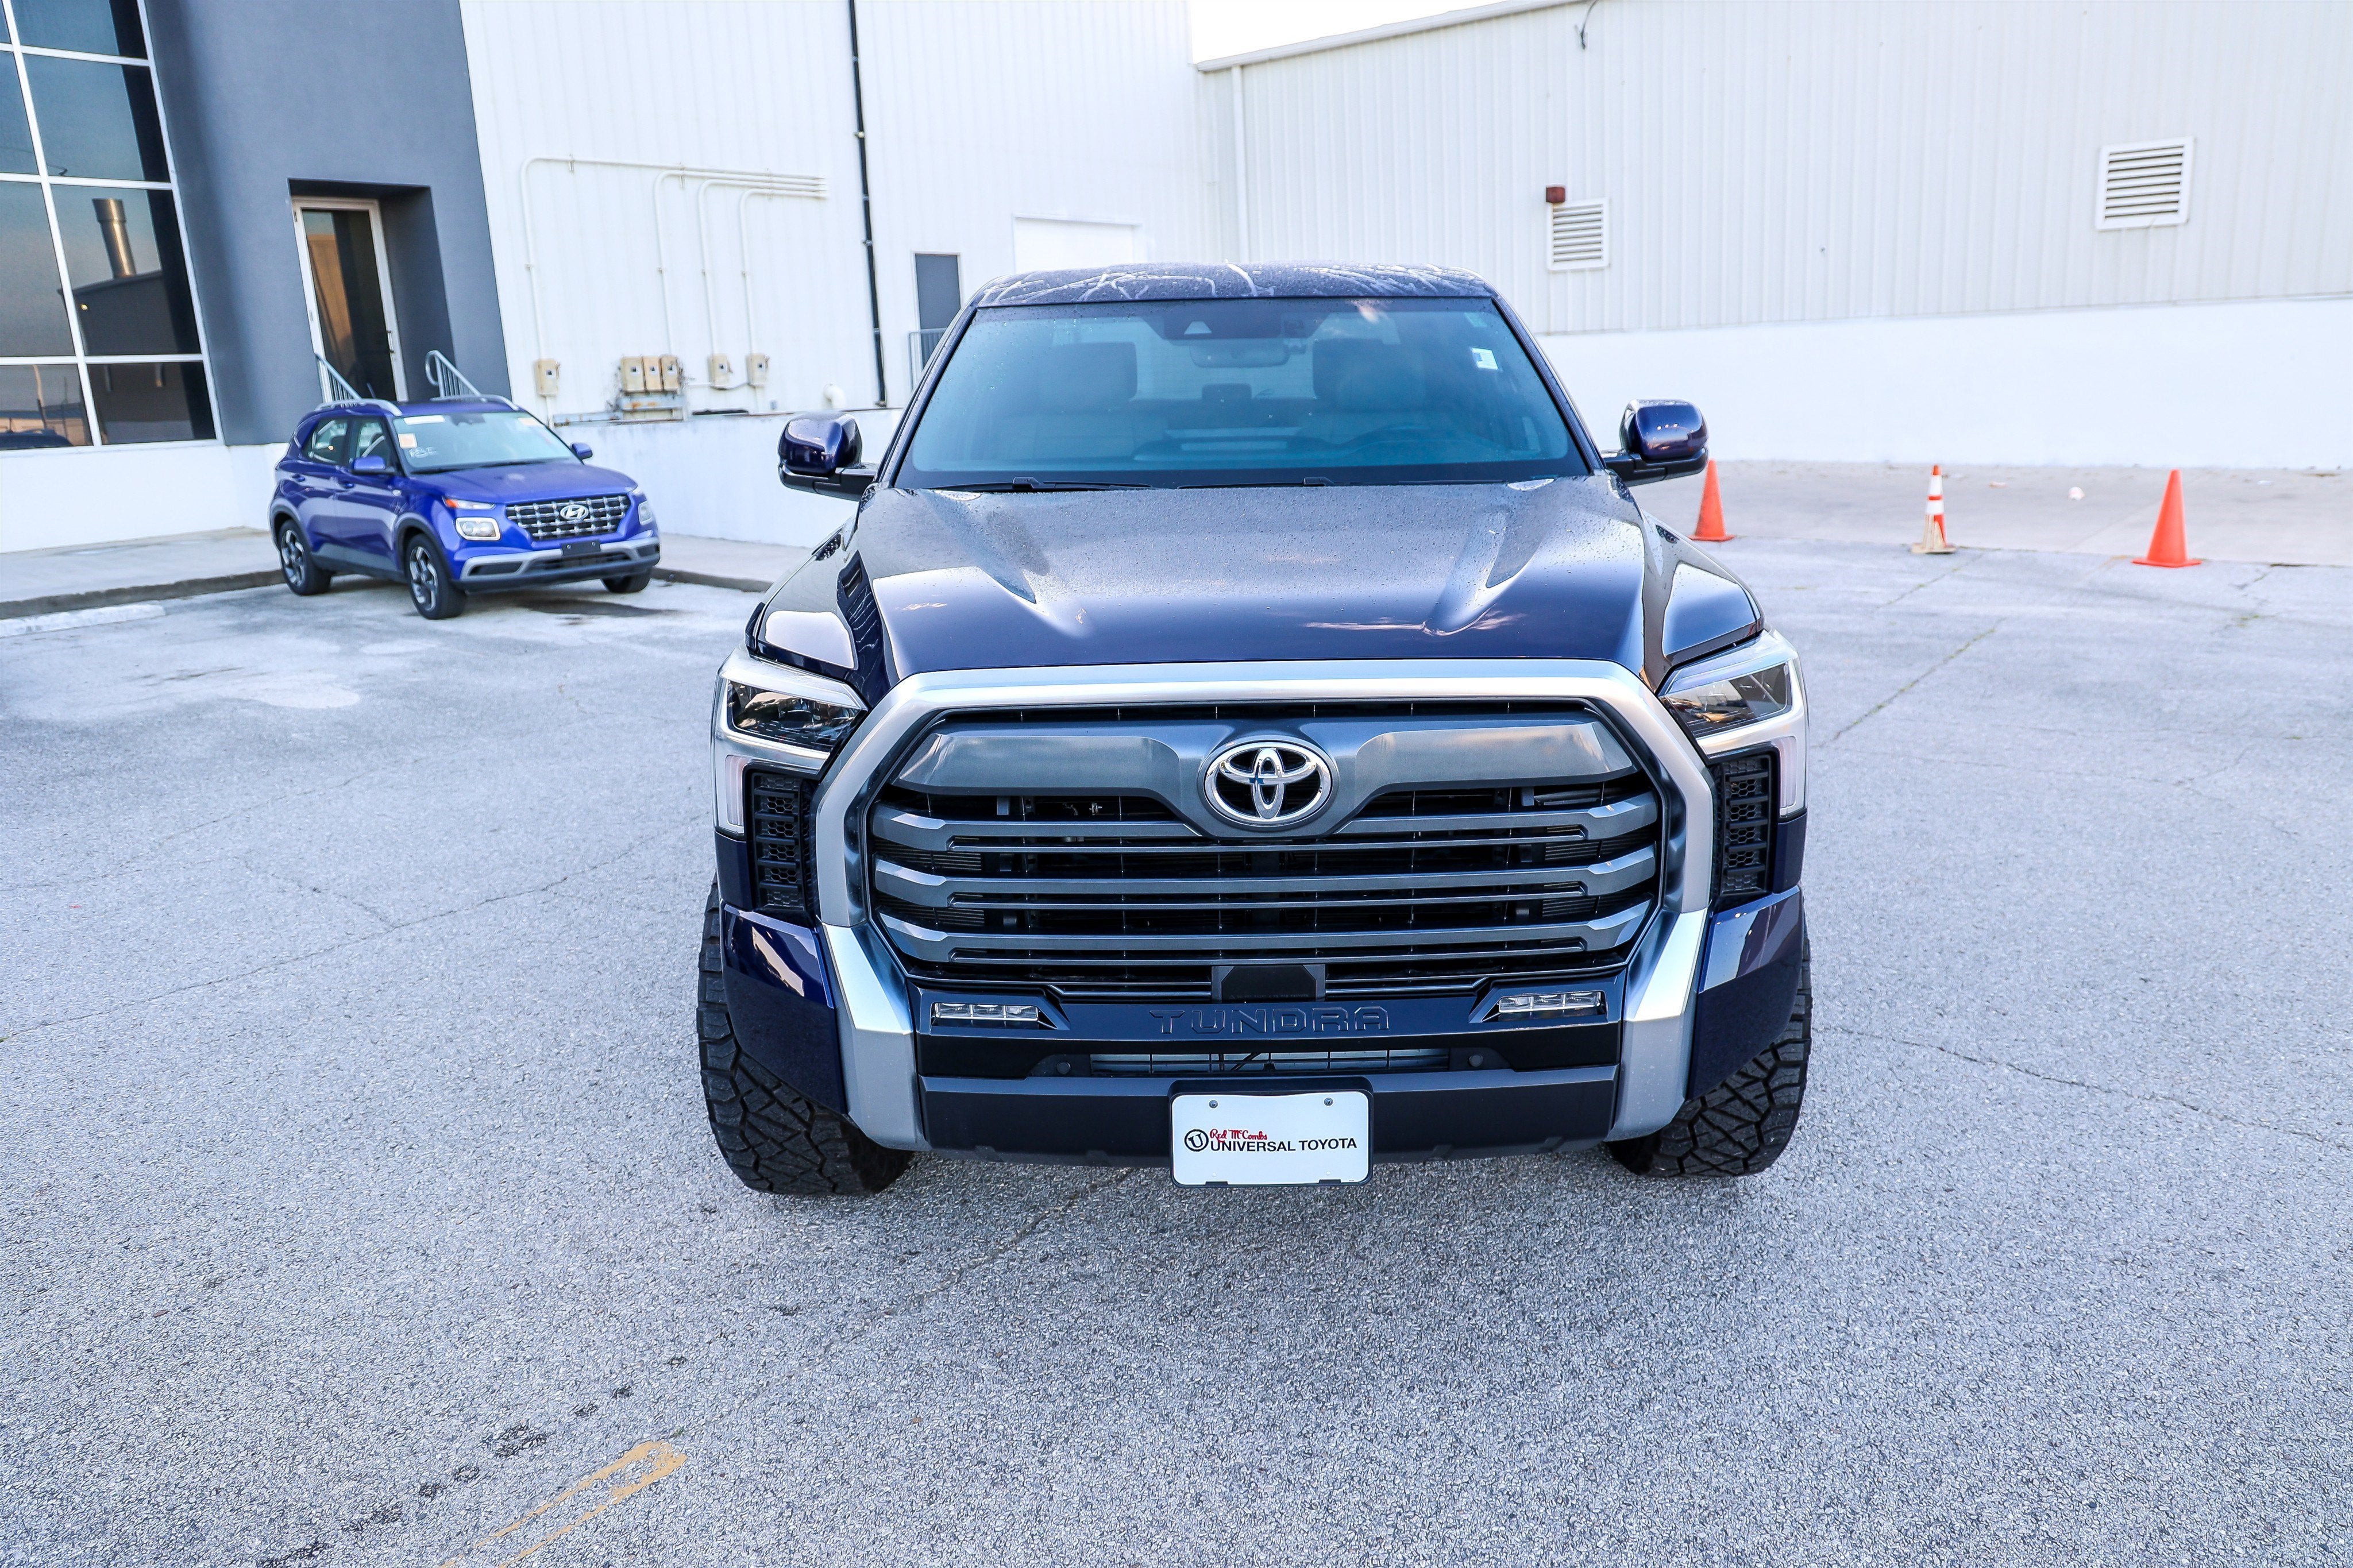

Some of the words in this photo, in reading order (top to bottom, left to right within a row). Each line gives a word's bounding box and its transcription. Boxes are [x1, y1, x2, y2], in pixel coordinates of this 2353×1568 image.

[1150, 1006, 1389, 1034] TUNDRA
[1209, 1129, 1227, 1142] Red
[1228, 1129, 1267, 1140] McCombs
[1210, 1141, 1296, 1152] UNIVERSAL
[1298, 1138, 1357, 1150] TOYOTA
